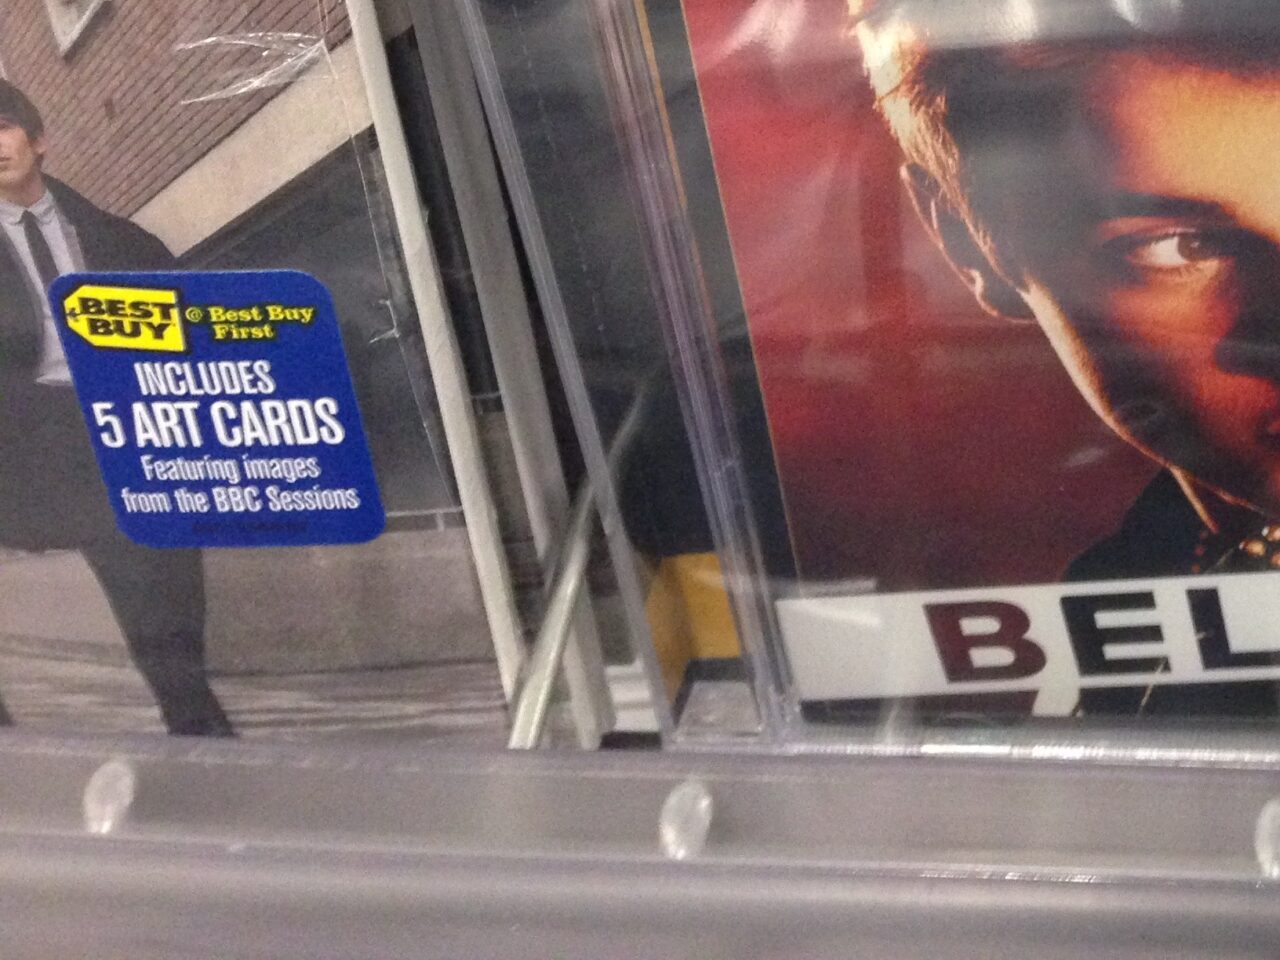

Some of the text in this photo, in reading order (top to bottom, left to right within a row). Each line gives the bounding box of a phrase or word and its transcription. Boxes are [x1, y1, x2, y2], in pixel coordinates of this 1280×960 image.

[77, 297, 177, 322] BEST
[208, 305, 263, 323] Best
[268, 305, 314, 324] Buy
[88, 318, 173, 340] BUY
[214, 324, 275, 340] First
[134, 360, 276, 396] INCLUDES
[92, 397, 346, 448] 5 ART CARDS
[140, 453, 321, 484] Featuring images
[121, 483, 361, 513] from the BBC Sessions
